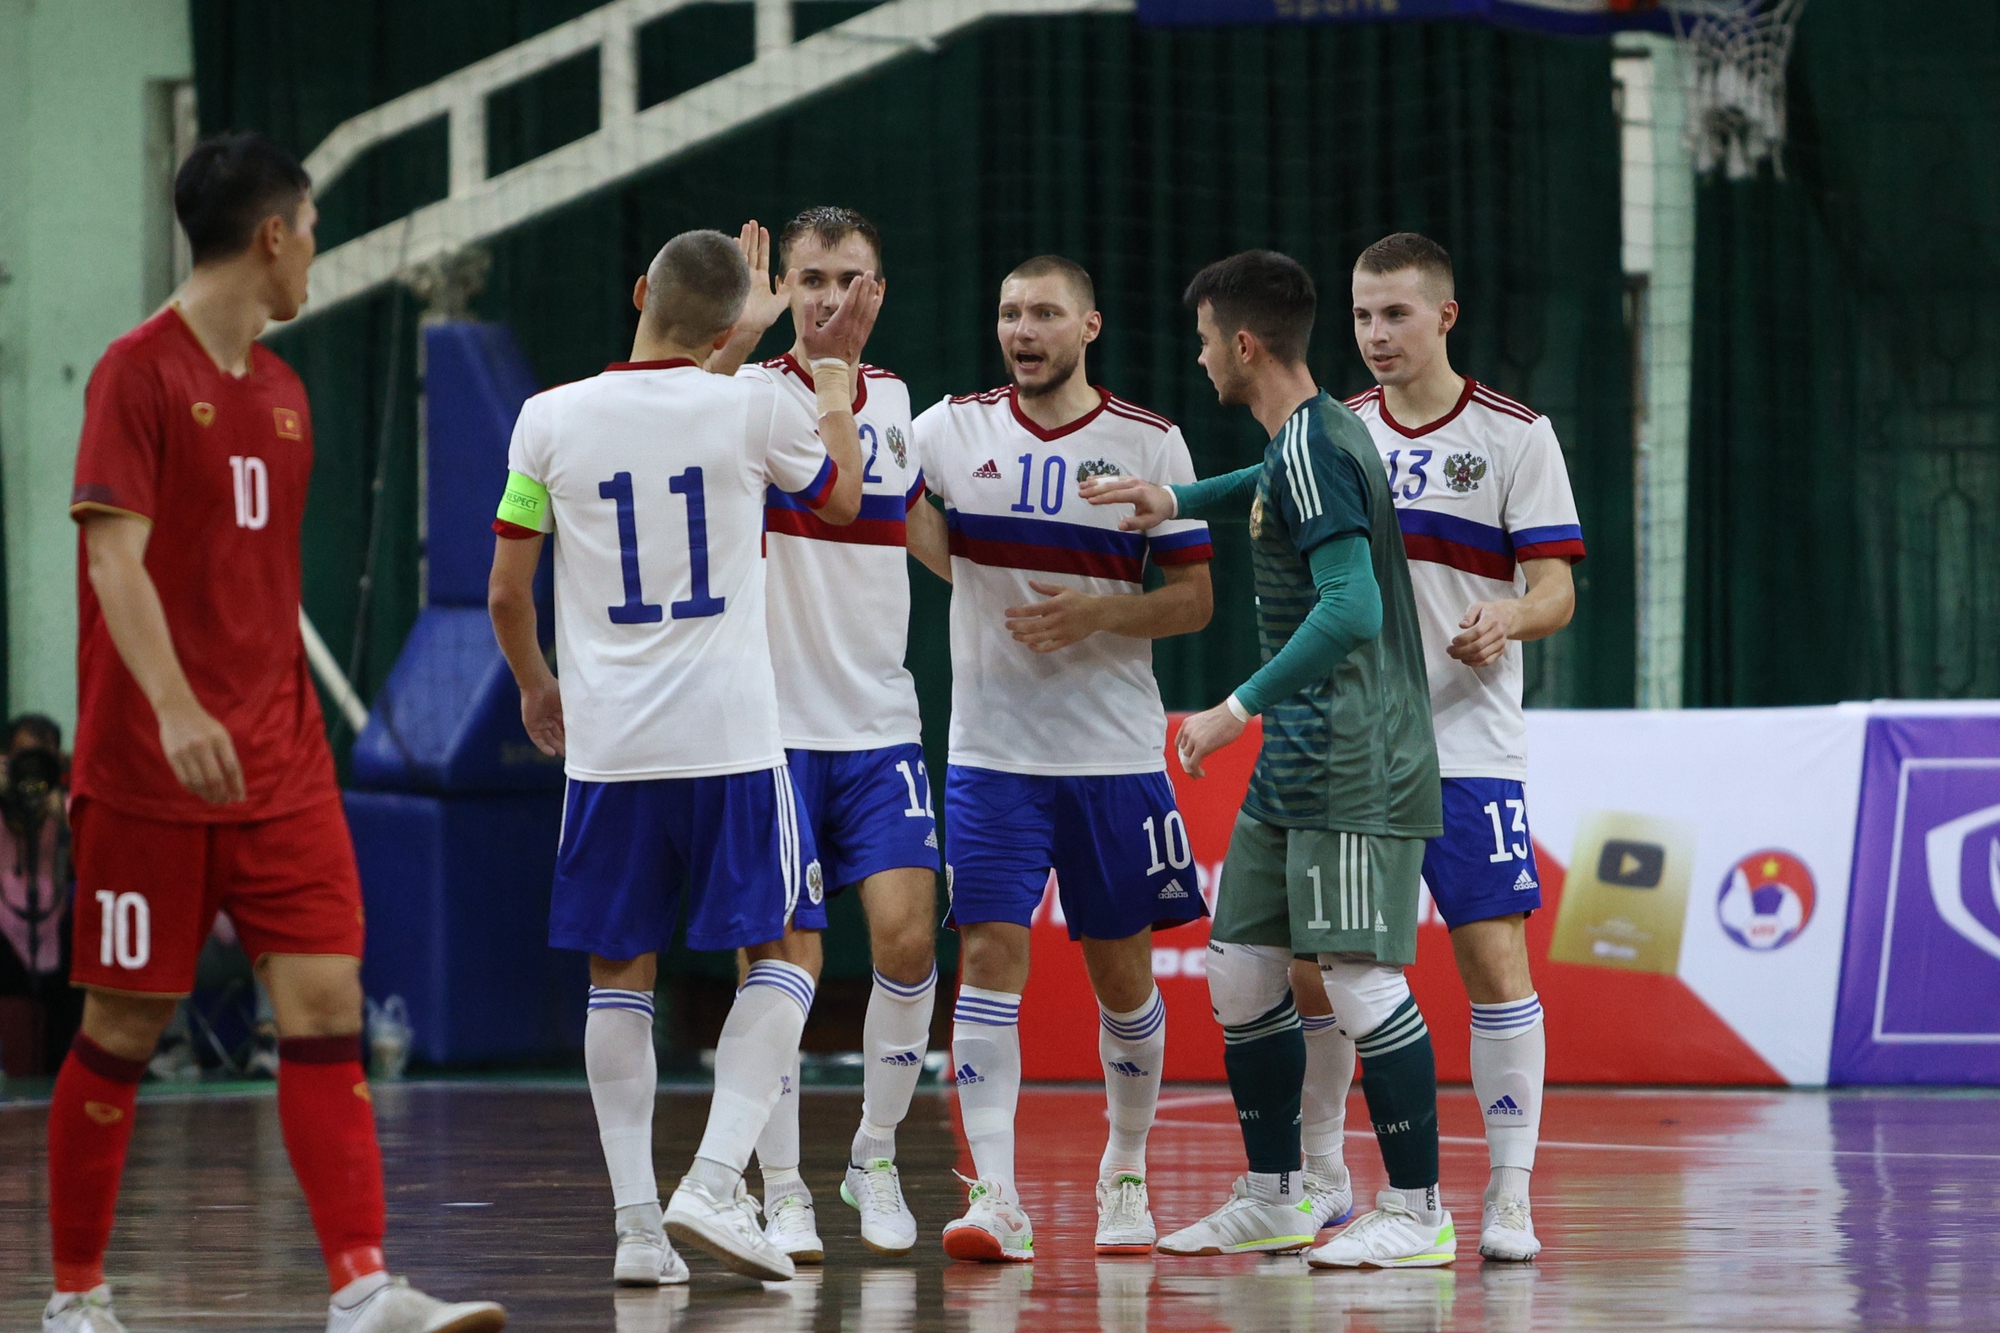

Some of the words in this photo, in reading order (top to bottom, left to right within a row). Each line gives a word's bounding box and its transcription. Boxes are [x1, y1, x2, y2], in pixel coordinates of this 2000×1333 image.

[858, 424, 882, 483] 2
[972, 471, 1002, 479] adidas
[1011, 453, 1066, 515] 10
[1386, 450, 1433, 500] 13
[229, 455, 269, 530] 10
[598, 466, 725, 624] 11
[1143, 810, 1191, 876] 10
[1484, 799, 1528, 863] 13
[1158, 890, 1189, 899] adidas
[1306, 865, 1331, 929] 1
[1513, 881, 1538, 890] adidas
[96, 889, 151, 970] 10
[1487, 1107, 1523, 1115] adidas
